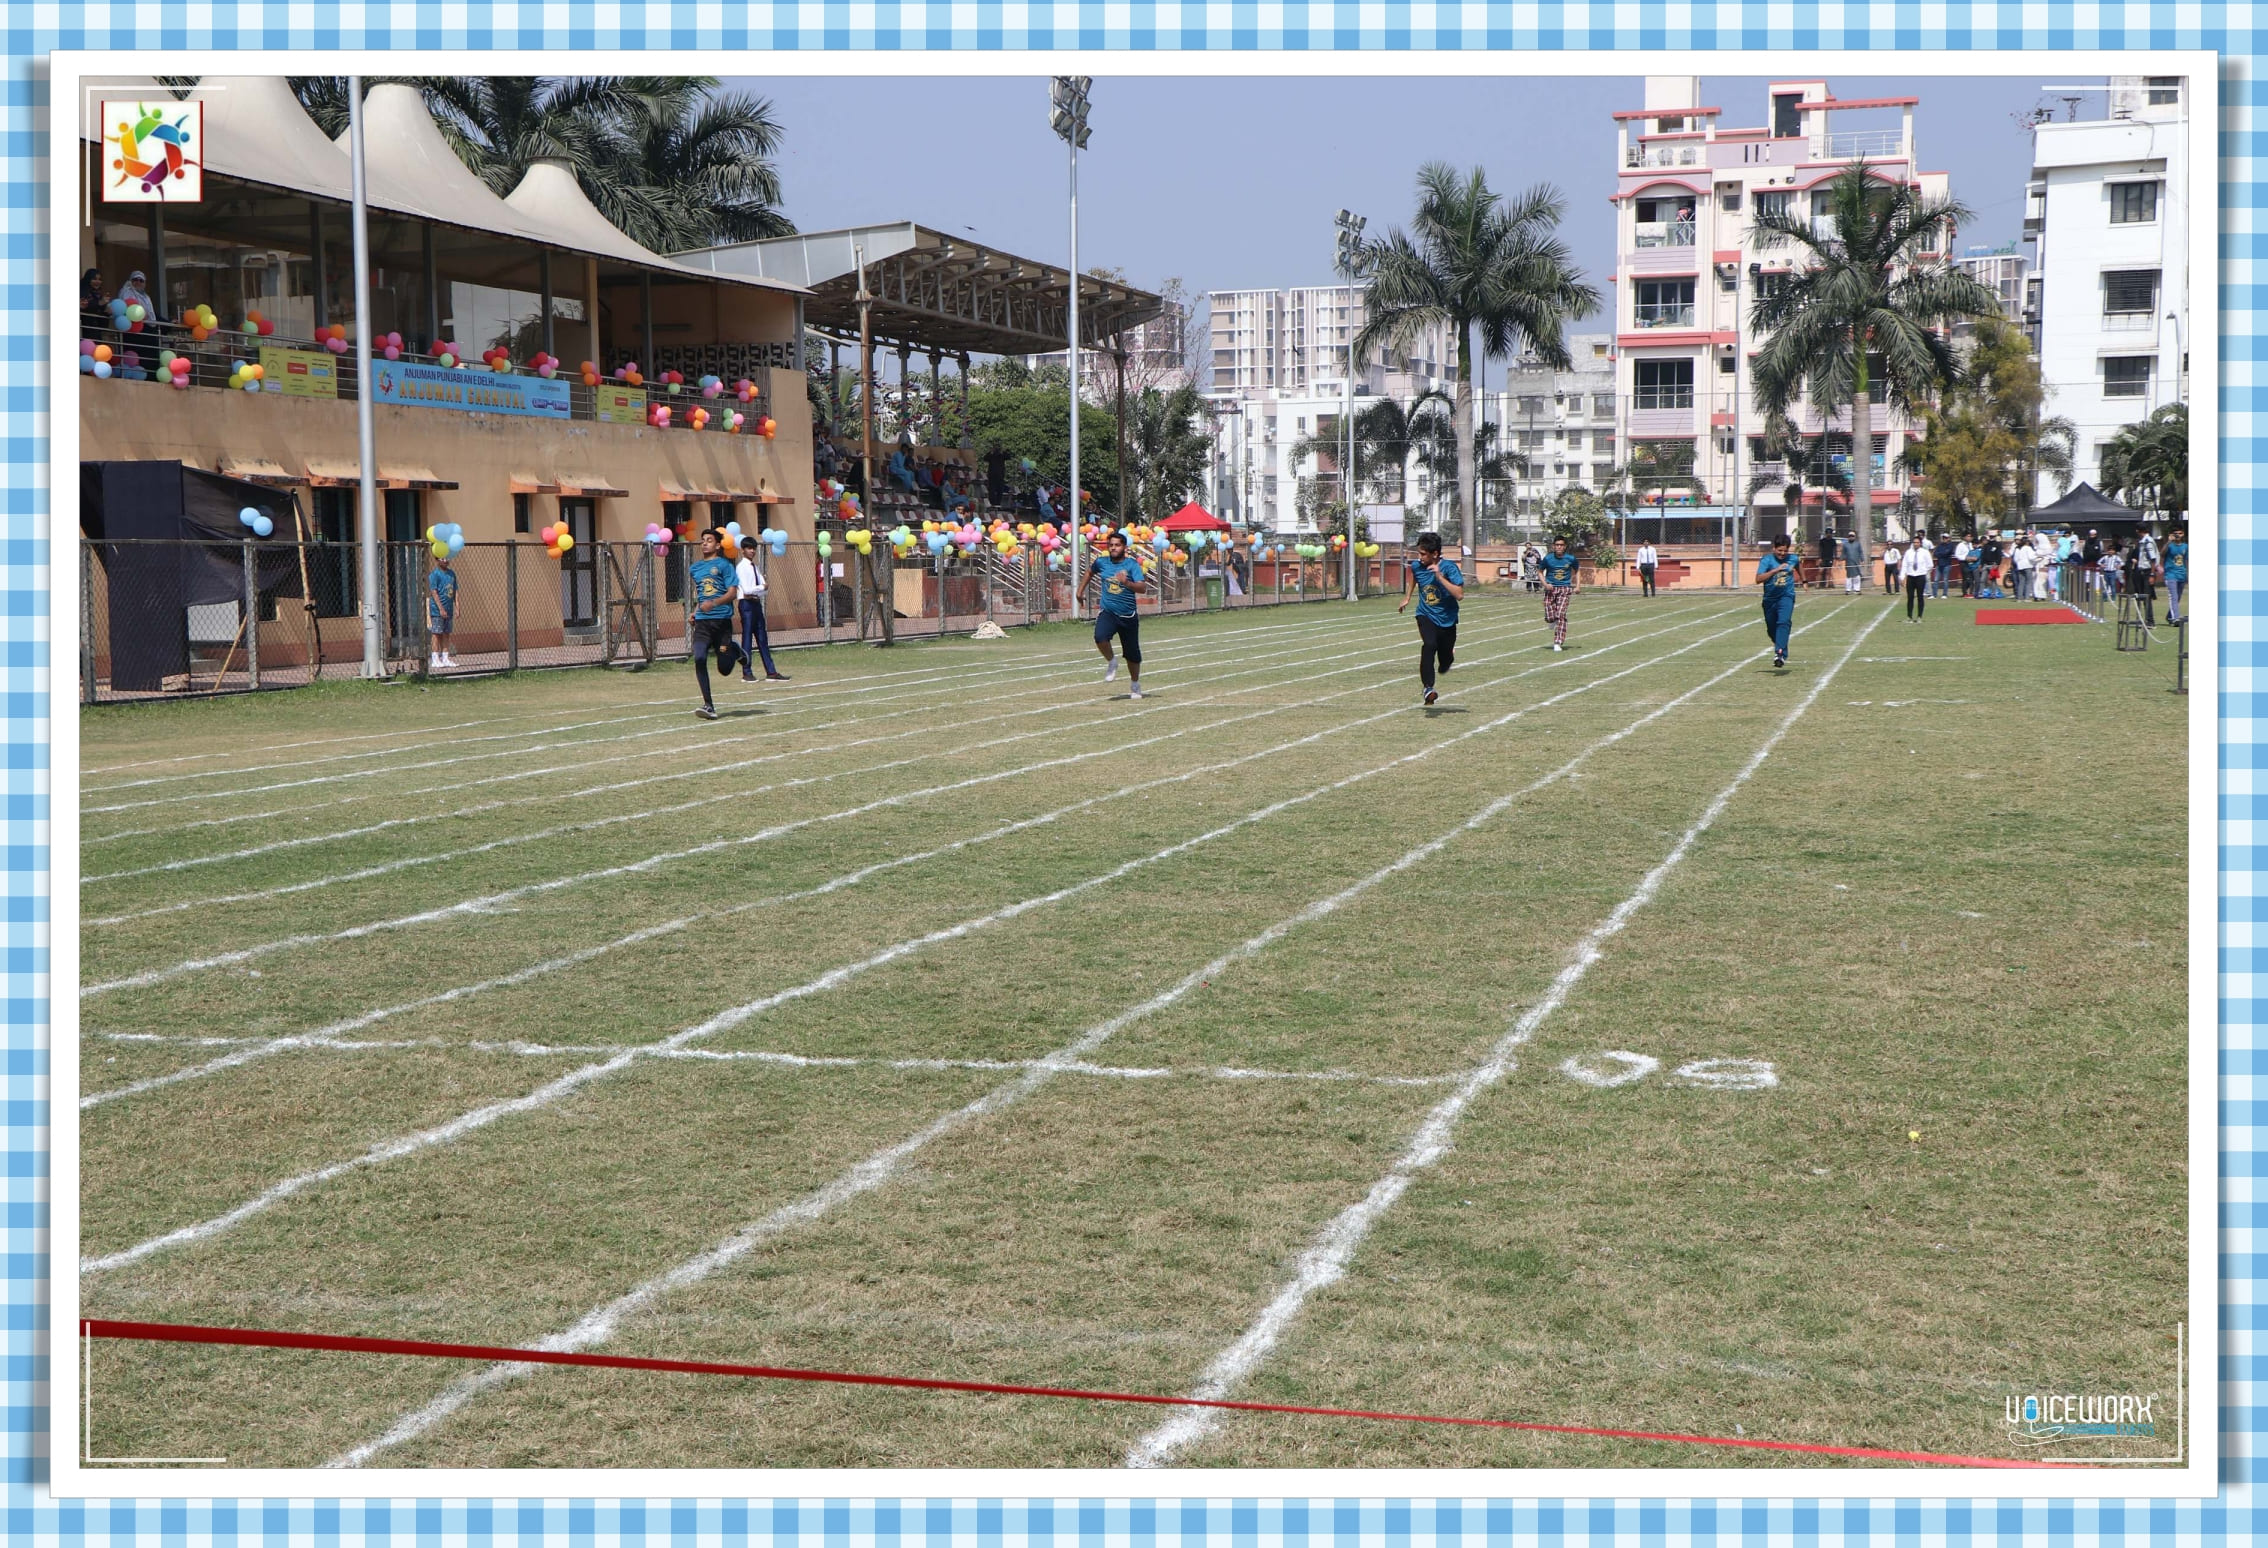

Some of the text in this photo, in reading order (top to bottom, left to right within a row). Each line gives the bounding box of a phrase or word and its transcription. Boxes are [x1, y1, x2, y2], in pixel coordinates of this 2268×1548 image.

[404, 368, 436, 381] ANJUMAN
[478, 376, 495, 387] DELHI
[400, 380, 462, 403] ANJUMAN
[467, 386, 526, 409] CARNIVAL
